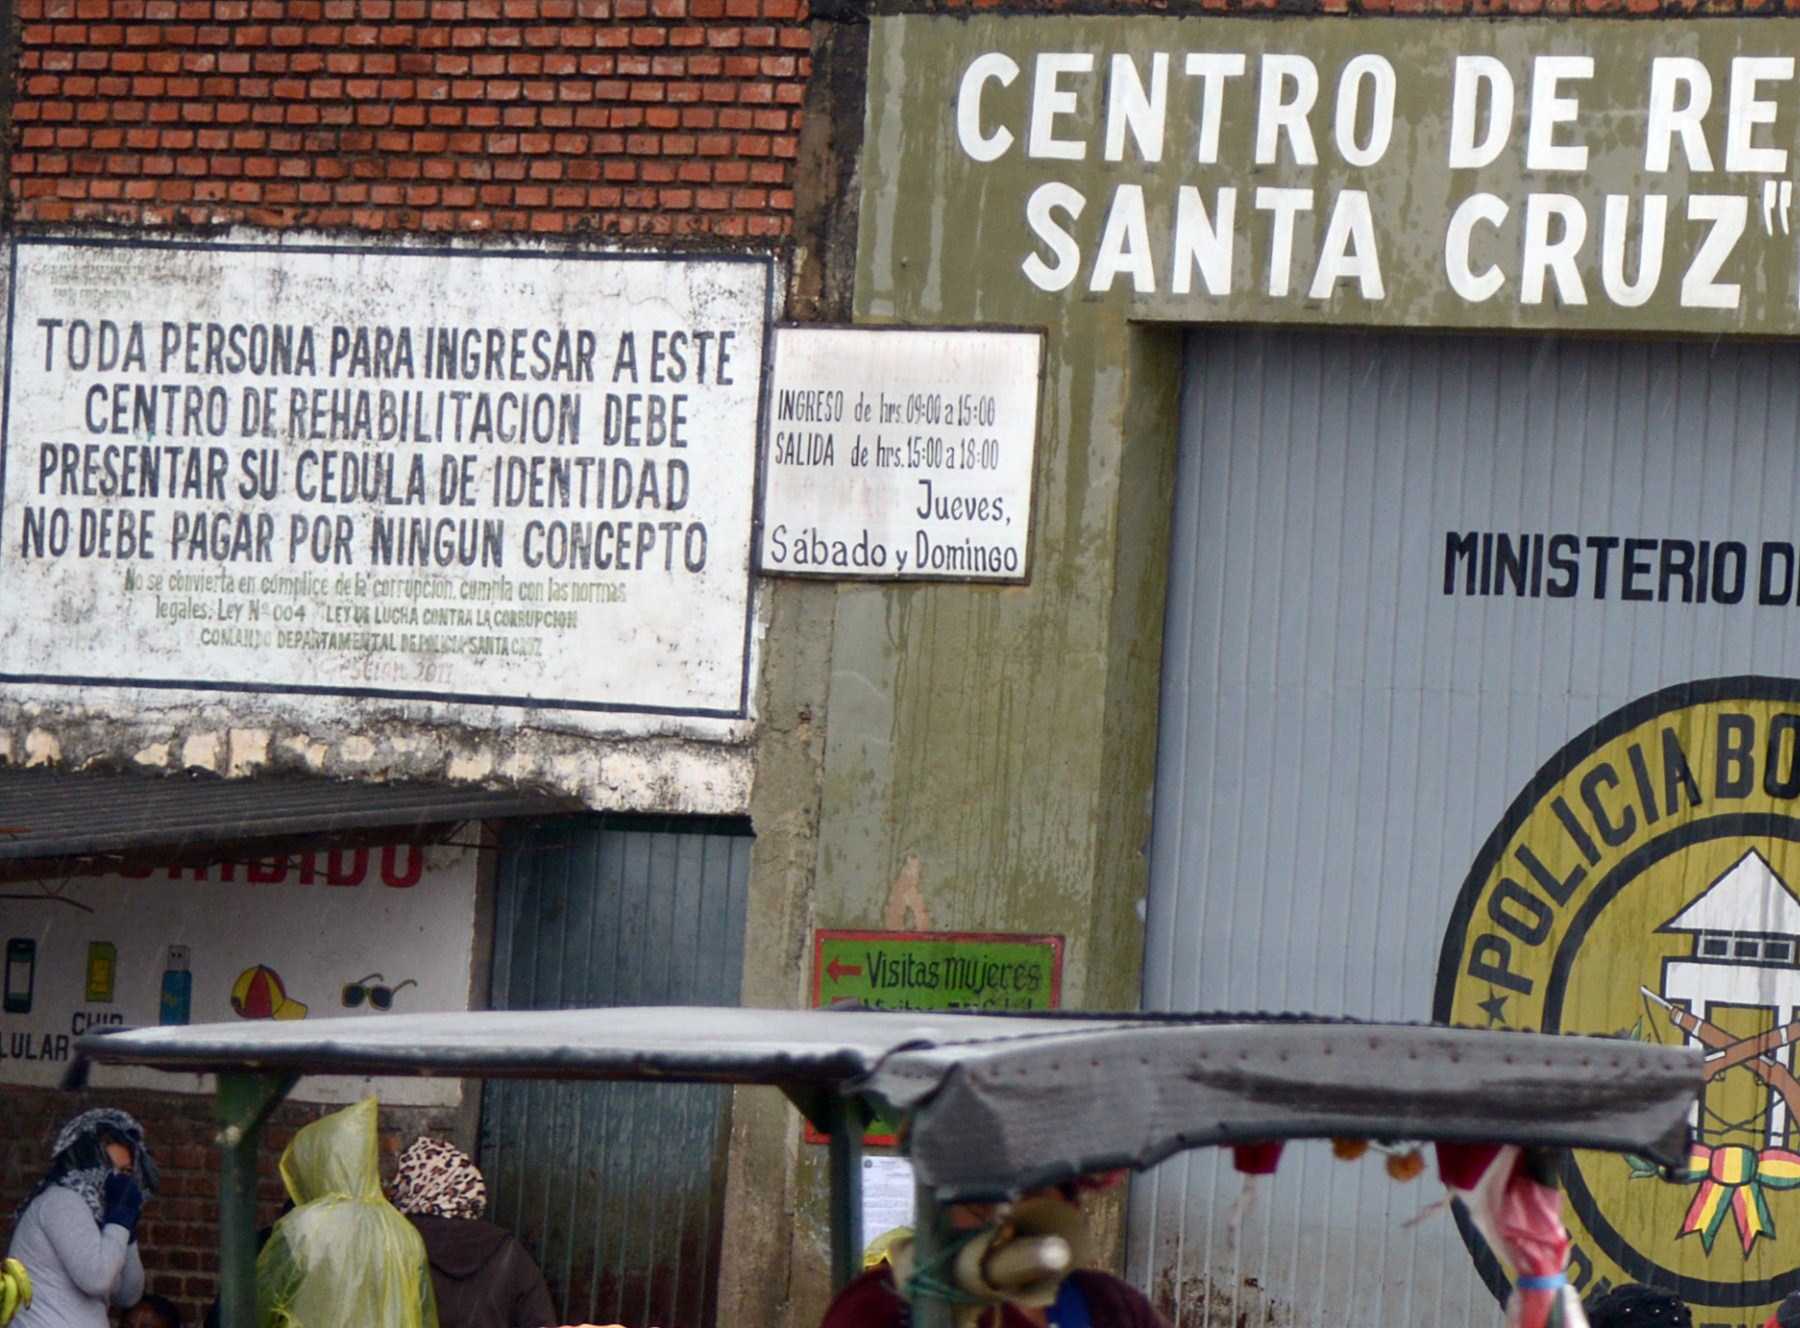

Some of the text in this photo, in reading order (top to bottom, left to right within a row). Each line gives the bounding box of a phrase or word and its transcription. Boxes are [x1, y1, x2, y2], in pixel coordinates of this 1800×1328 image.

[958, 53, 1396, 167] CENTRO
[1449, 56, 1594, 171] DE
[1023, 183, 1385, 300] SANTA
[1446, 193, 1747, 309] CRUZ
[38, 319, 735, 386] TODA PERSONA PARA INGRESAR A ESTE
[85, 384, 688, 448] CENTRO DE REHABILITACION DEBE
[778, 389, 844, 423] INGRESO
[855, 394, 871, 423] de
[907, 394, 941, 425] 09:00
[945, 404, 954, 425] a
[958, 395, 995, 427] 15:00
[39, 443, 689, 512] PRESENTAR SU CEDULA DE IDENTIDAD
[775, 432, 835, 467] SALIDA
[851, 437, 869, 468] de
[907, 437, 943, 469] 15:00
[945, 445, 955, 469] a
[961, 438, 999, 470] 18:00
[917, 479, 1012, 525] Jueves,
[21, 507, 708, 574] NO DEBE PAGAR POR NINGUN CONCEPTO
[771, 524, 1018, 573] Sábado y Domingo
[1443, 531, 1747, 605] MINISTERIO
[147, 577, 162, 591] se
[519, 581, 543, 601] con
[549, 577, 568, 601] las
[218, 599, 243, 627] Ley
[374, 607, 418, 625] LUCHA
[423, 609, 472, 626] CONTRA
[477, 611, 491, 627] LA
[494, 610, 577, 628] CORRUPCION
[277, 627, 396, 651] DEPARTAMENTAL
[469, 636, 509, 656] SANTA
[1467, 725, 1703, 997] POLICIA
[866, 951, 940, 988] Visitas
